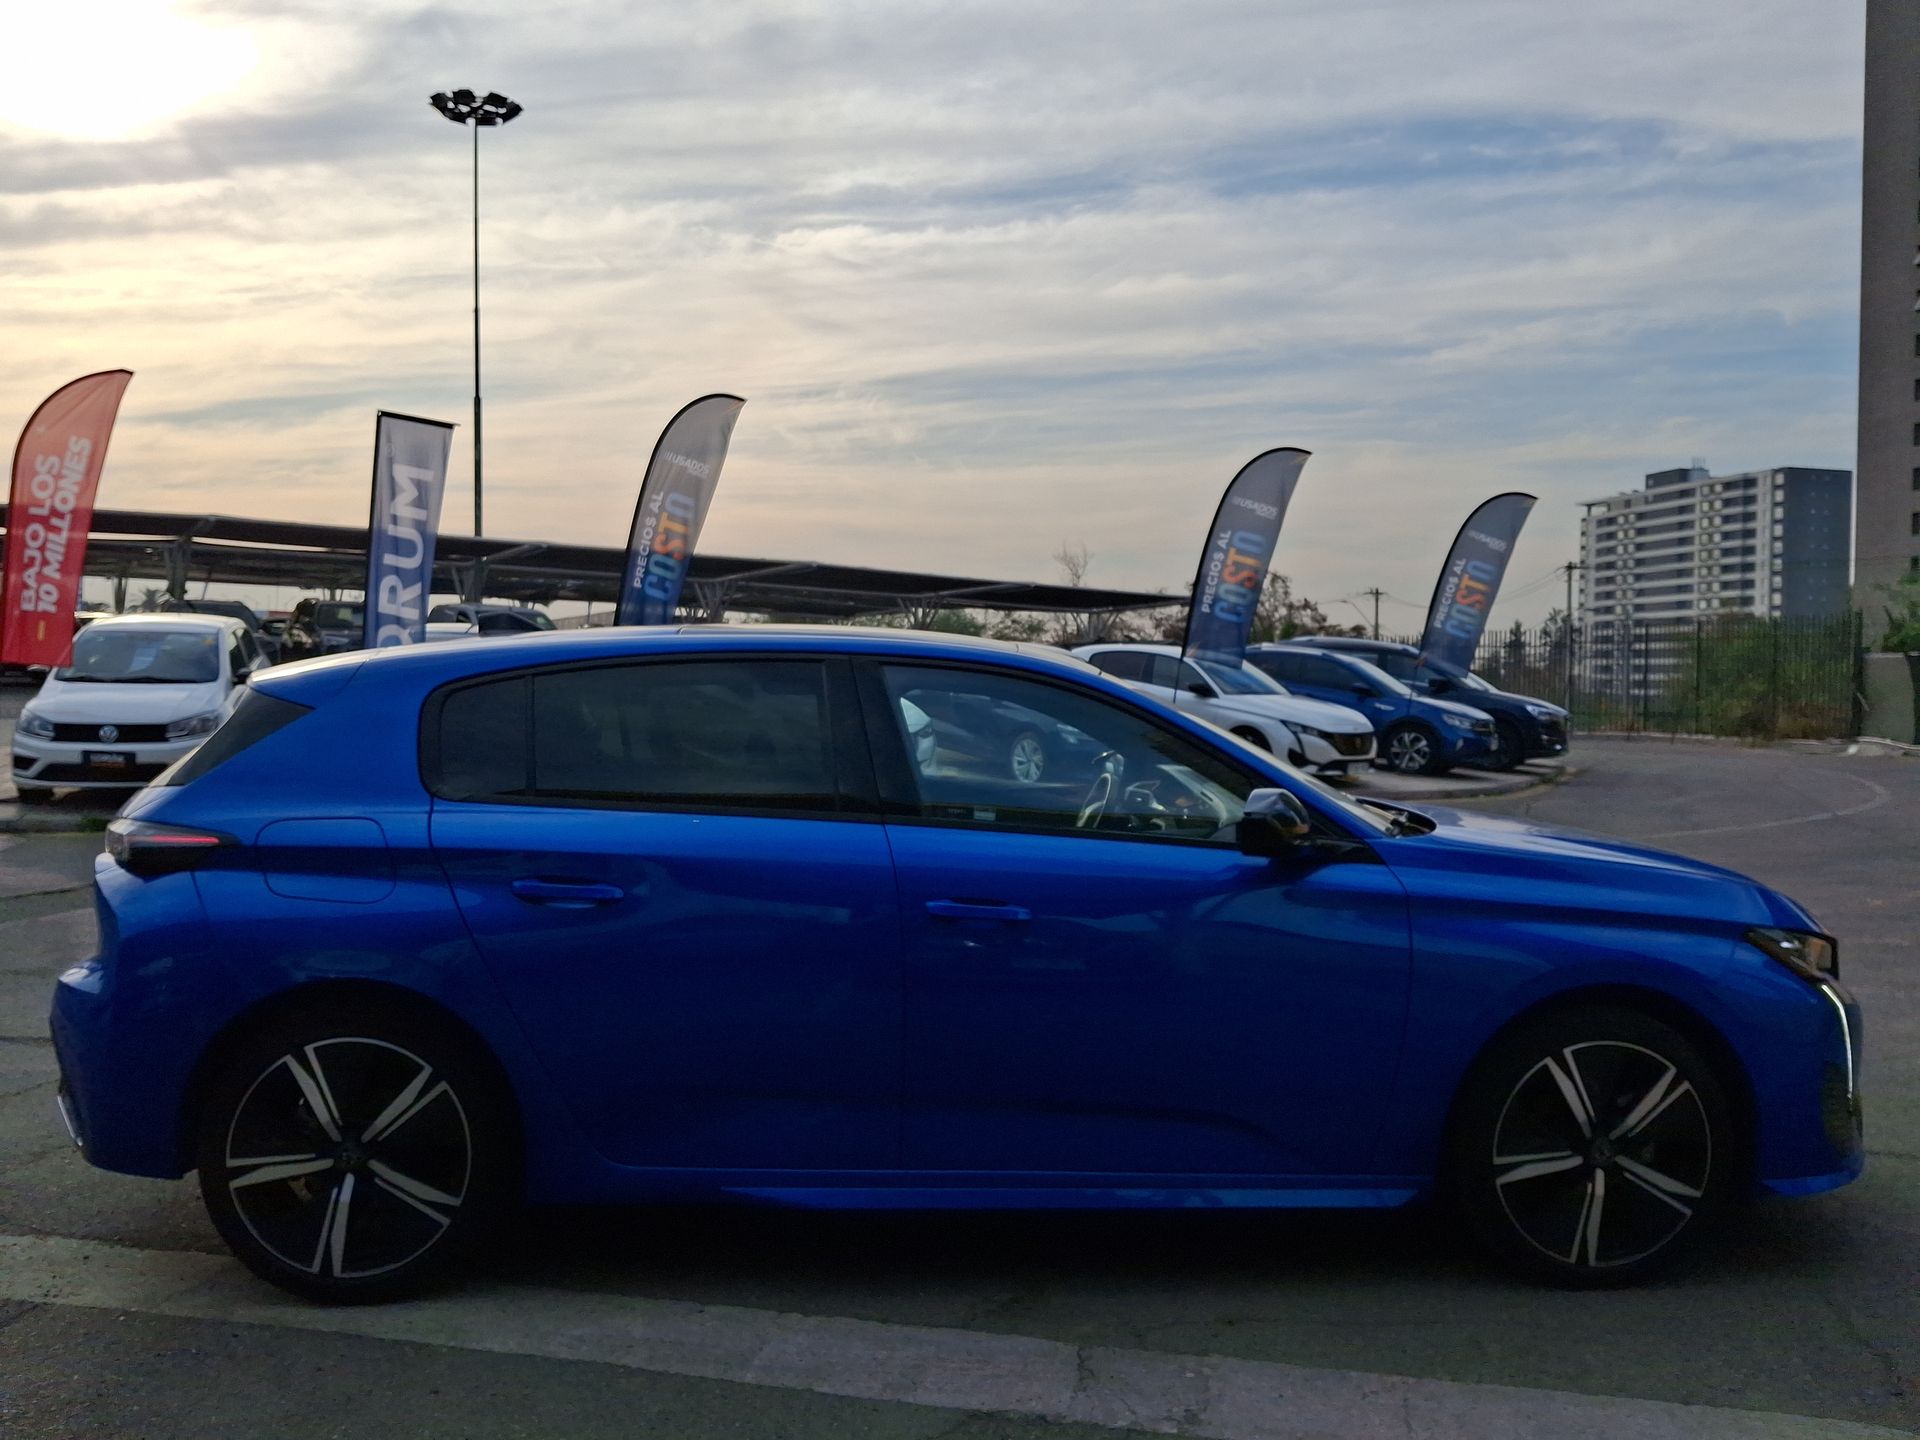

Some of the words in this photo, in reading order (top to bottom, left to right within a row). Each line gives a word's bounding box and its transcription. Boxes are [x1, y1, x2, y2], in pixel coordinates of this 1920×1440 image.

[28, 455, 61, 516] LOS
[42, 435, 92, 580] MILLONES
[20, 522, 46, 612] BAJO
[633, 515, 657, 588] PRECIOS
[649, 491, 664, 513] AL
[643, 492, 696, 600] COSTO
[1201, 551, 1226, 614] PRECIOS
[1218, 530, 1231, 550] AL
[1214, 531, 1266, 623] COSTO
[36, 582, 59, 614] 10
[1433, 577, 1459, 629] PRECIOS
[1453, 558, 1467, 574] AL
[1445, 560, 1498, 640] COSTO
